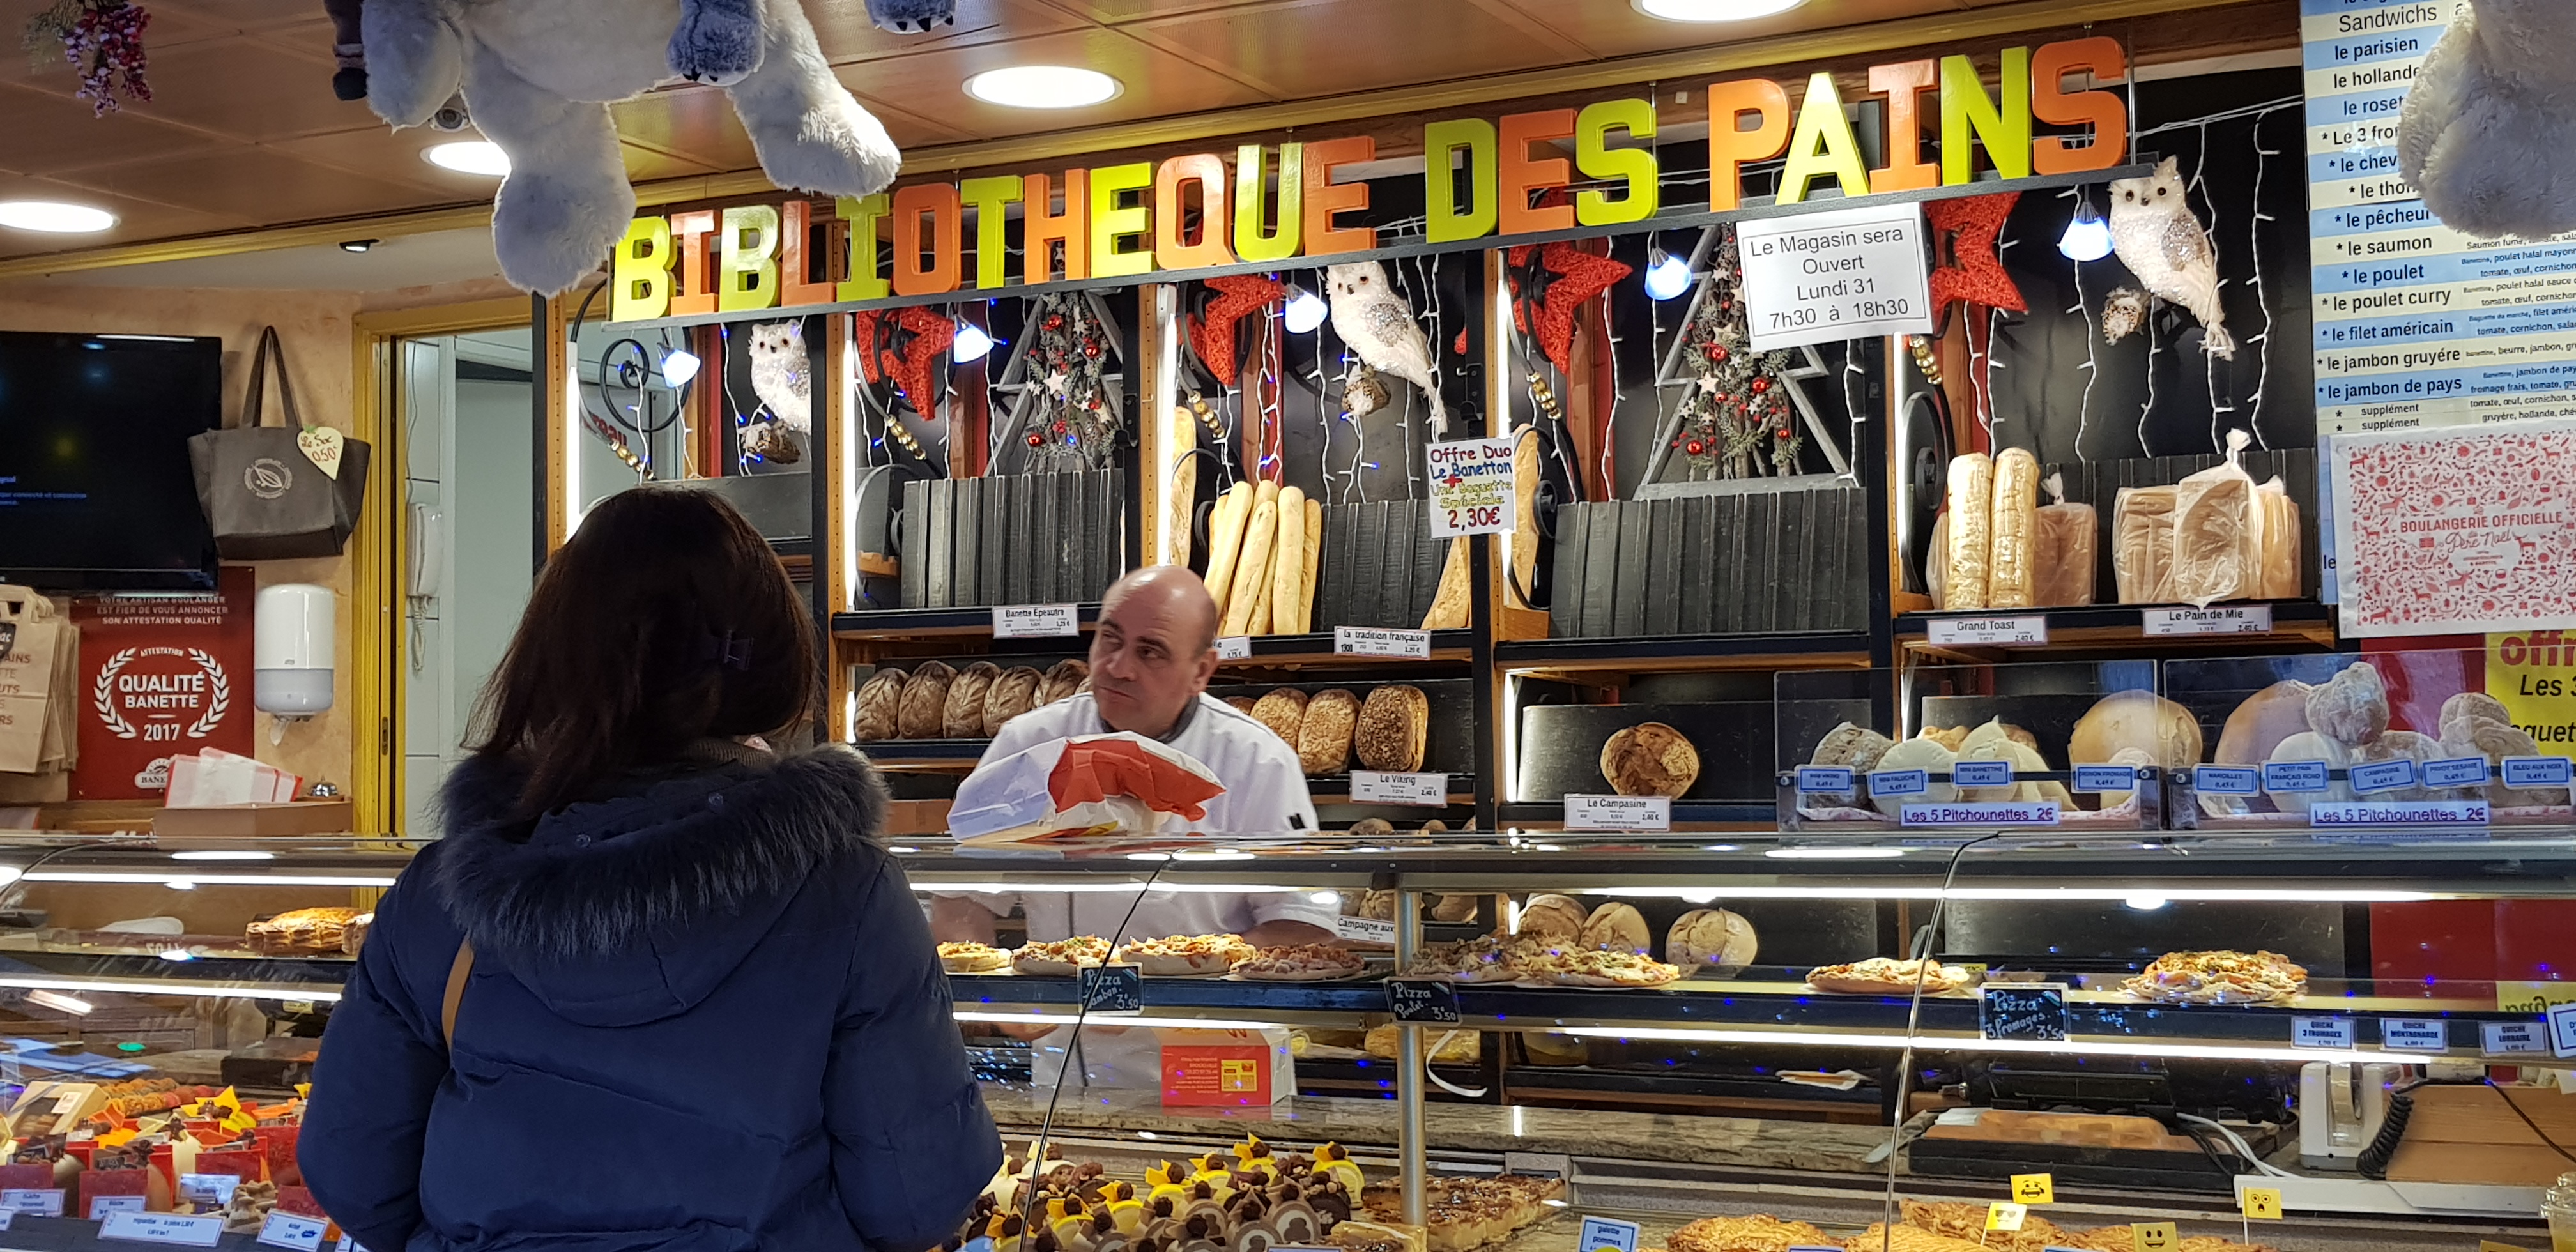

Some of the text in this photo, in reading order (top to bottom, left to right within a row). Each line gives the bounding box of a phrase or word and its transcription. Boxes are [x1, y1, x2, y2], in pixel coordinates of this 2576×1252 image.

[2339, 5, 2437, 33] Sandwichs
[2334, 37, 2419, 60] le parisien
[2333, 73, 2347, 88] le
[2343, 100, 2358, 115] le
[2333, 130, 2352, 145] Le
[2357, 128, 2366, 142] 3
[2340, 157, 2355, 172] le
[611, 36, 2128, 322] BIBLIOTHEQUE DES PAINS
[2361, 185, 2374, 199] le
[2346, 212, 2361, 228] le
[1751, 228, 1903, 257] Le Magasin sera
[2348, 236, 2432, 256] le saumon
[1802, 255, 1865, 274] Ouvert
[2353, 264, 2425, 286] le poulet
[1797, 277, 1875, 301] Lundi 31
[2333, 288, 2451, 314] le poulet curry
[1770, 298, 1909, 330] 7h30 à 18h30
[2333, 319, 2454, 342] le filet américain
[2327, 347, 2460, 373] le jambon gruyére
[2328, 377, 2462, 401] le jambon de pays
[2361, 403, 2419, 417] supplément
[2361, 417, 2420, 431] supplément
[1430, 444, 1512, 463] Offre Duo
[1430, 461, 1513, 480] Le Banetton
[1447, 505, 1501, 531] 2,30€
[2400, 511, 2563, 533] BOULANGERIE OFFICIELLE
[102, 615, 222, 625] SON ATTESTATION QUALITÉ
[138, 606, 150, 615] DE
[152, 606, 176, 615] VOUS
[2169, 609, 2244, 621] Le Pain de Mie
[1956, 620, 2016, 631] Grand Toast
[139, 646, 185, 657] ATTESTATION
[119, 670, 206, 693] QUALITÉ
[2519, 673, 2563, 696] Les
[125, 694, 200, 709] BANETTE
[143, 723, 181, 742] 2017
[1380, 774, 1390, 783] Le
[1587, 798, 1598, 808] Le
[1904, 807, 2054, 822] Les 5 Pitchounettes 2€
[2314, 807, 2485, 823] Les 5 Pitchounettes 2€
[1337, 917, 1379, 932] Campagne
[1391, 982, 1432, 998] Pizza
[1992, 989, 2038, 1012] Pizza
